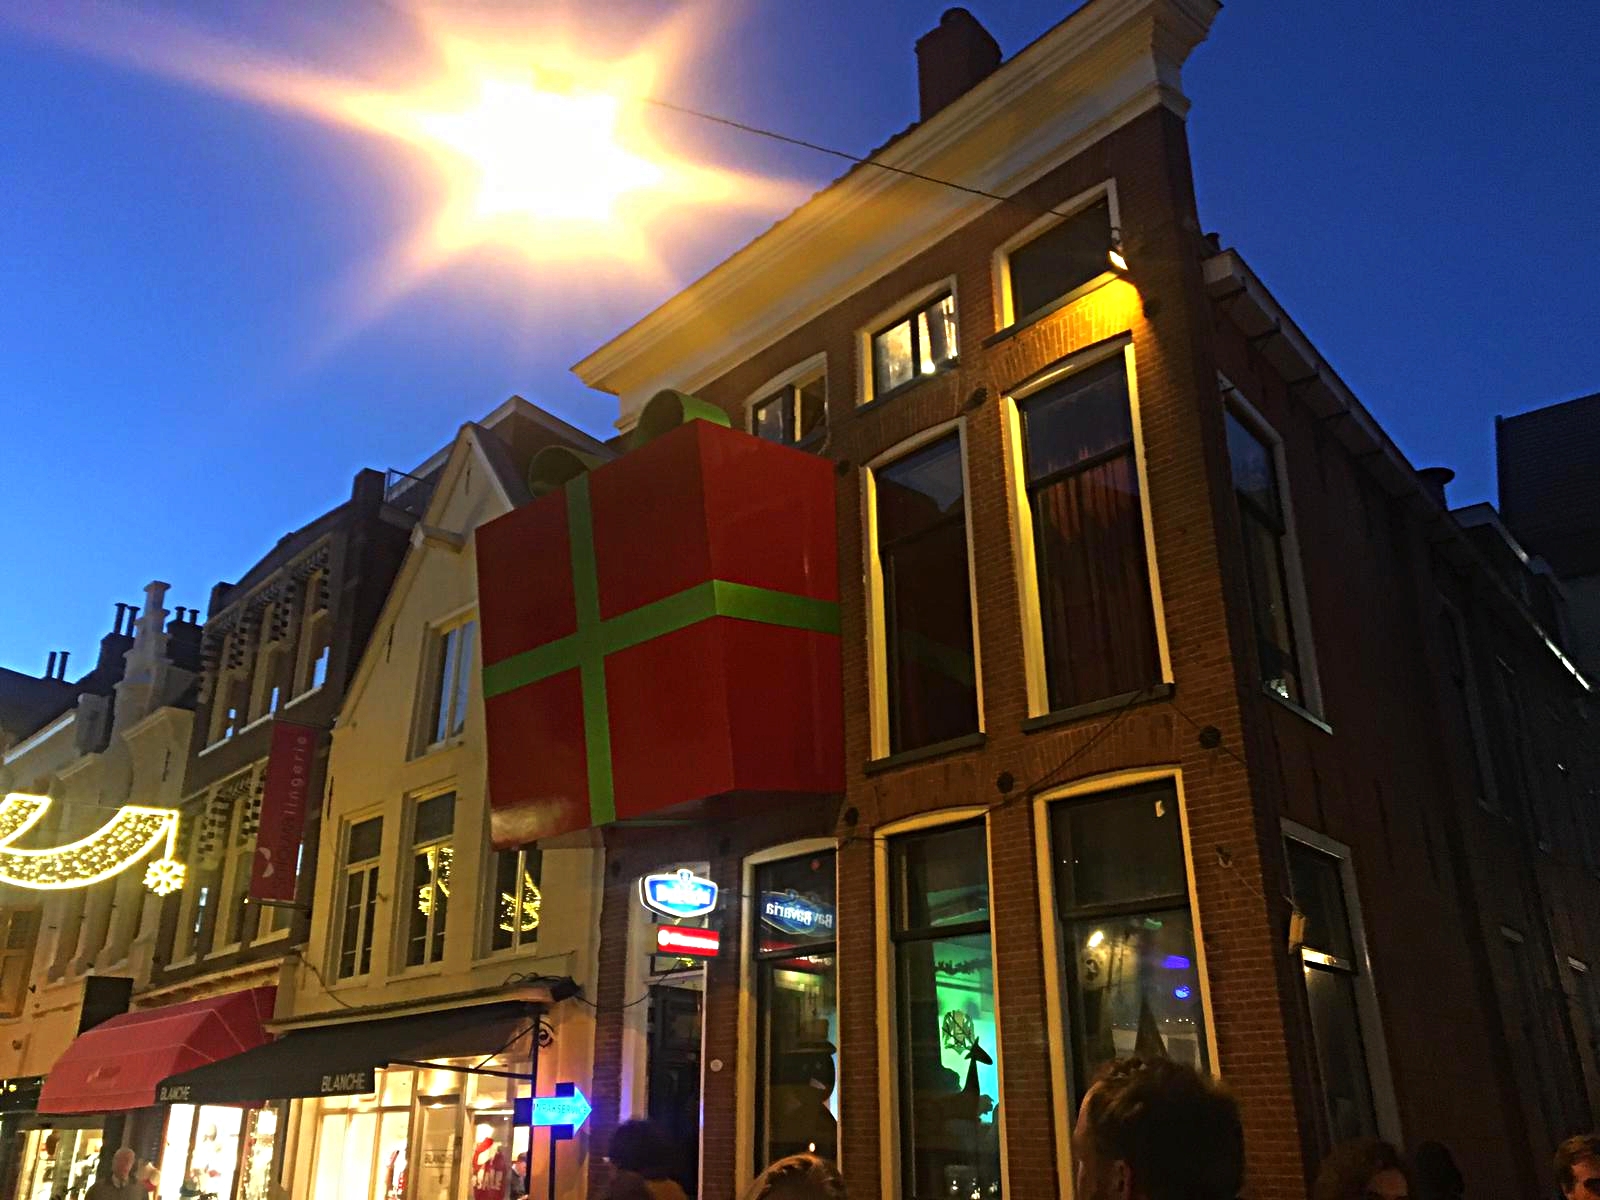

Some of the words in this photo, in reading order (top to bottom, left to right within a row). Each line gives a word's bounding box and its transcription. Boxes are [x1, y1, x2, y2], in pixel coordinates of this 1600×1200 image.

[284, 736, 307, 814] lingerie
[320, 1073, 365, 1092] BLANCHE
[160, 1086, 191, 1101] BLANCHE
